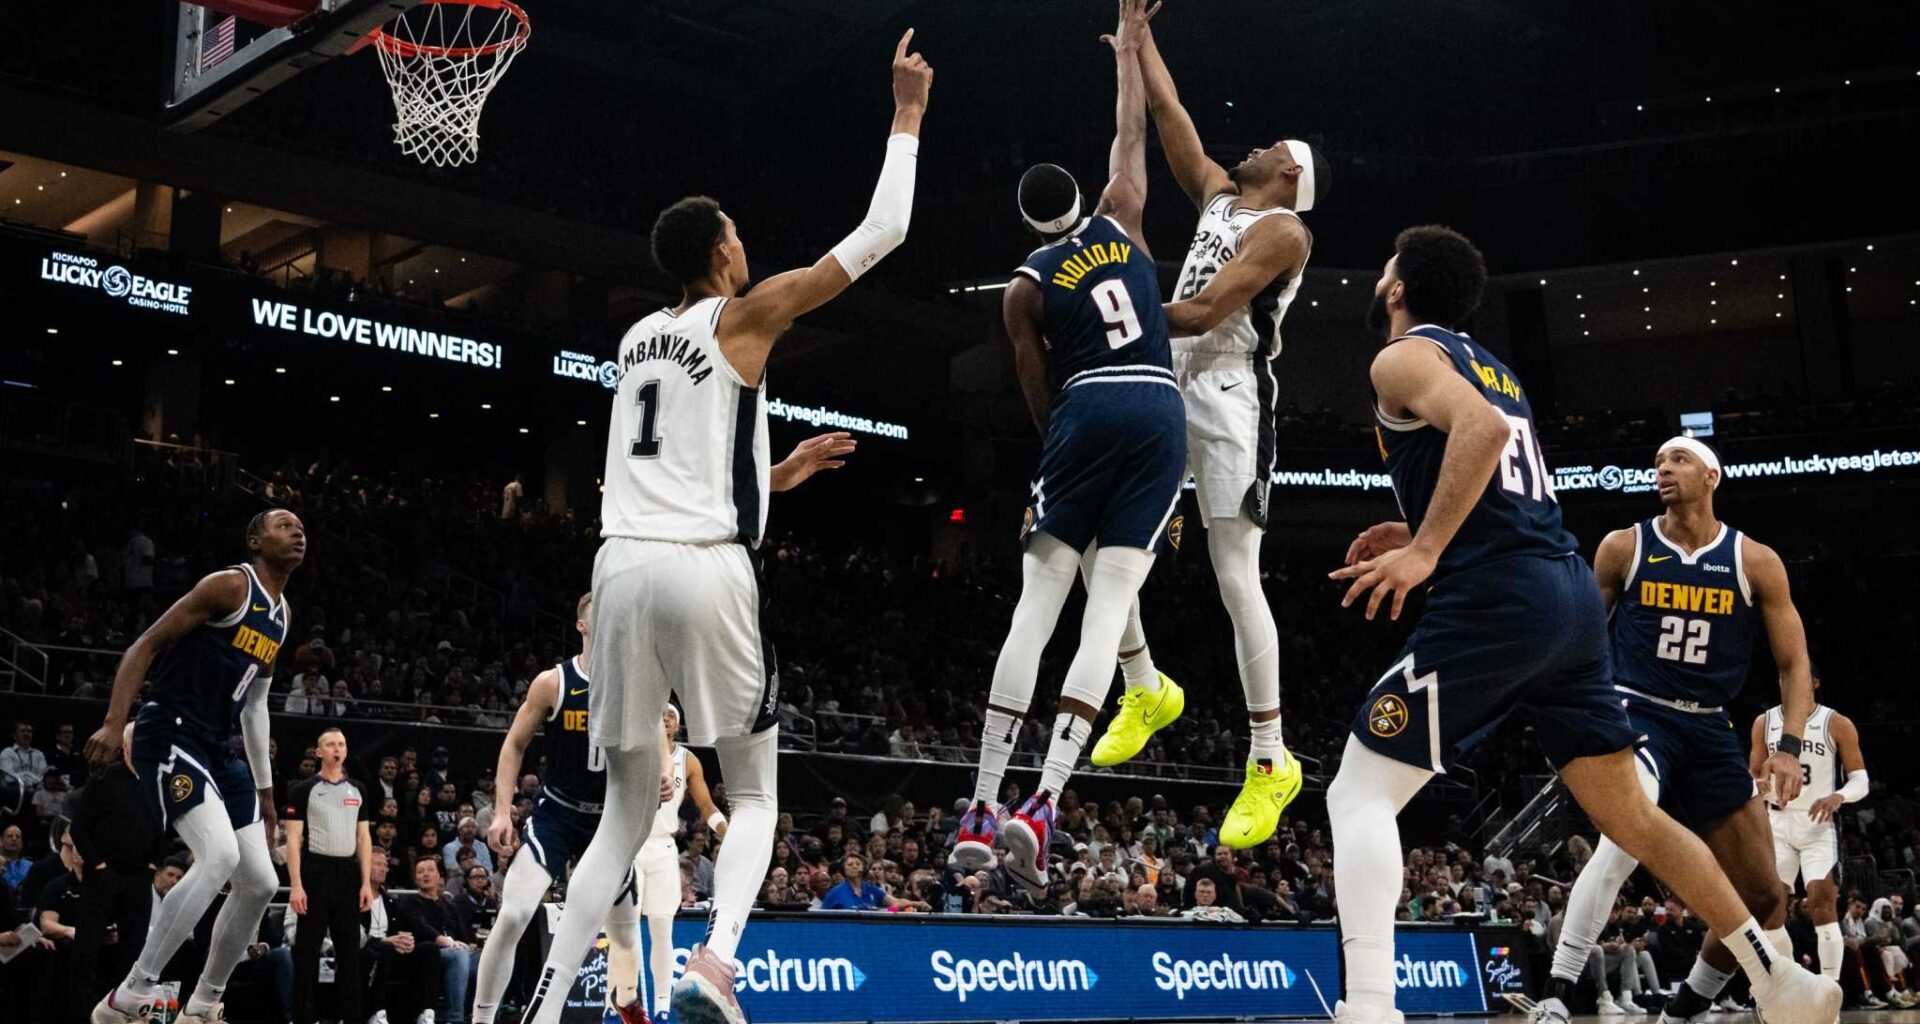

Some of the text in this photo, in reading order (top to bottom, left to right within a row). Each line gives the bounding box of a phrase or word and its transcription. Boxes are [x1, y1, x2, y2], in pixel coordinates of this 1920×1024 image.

[41, 258, 192, 305] LUCKY EAGLE
[52, 251, 98, 267] KICKAPOO
[1052, 241, 1131, 290] HOLIDAY
[252, 298, 502, 369] WE LOVE WINNERS!
[1090, 279, 1143, 350] 9
[553, 356, 600, 382] LUCKY
[616, 334, 713, 394] EMBANYAMA
[627, 379, 663, 459] 1
[1549, 473, 1599, 491] LUCKY
[1703, 563, 1730, 573] ibotta
[1641, 580, 1734, 615] DENVER
[1656, 616, 1711, 664] 22
[931, 950, 1090, 1002] Spectrum
[1152, 951, 1288, 1000] Spectrum
